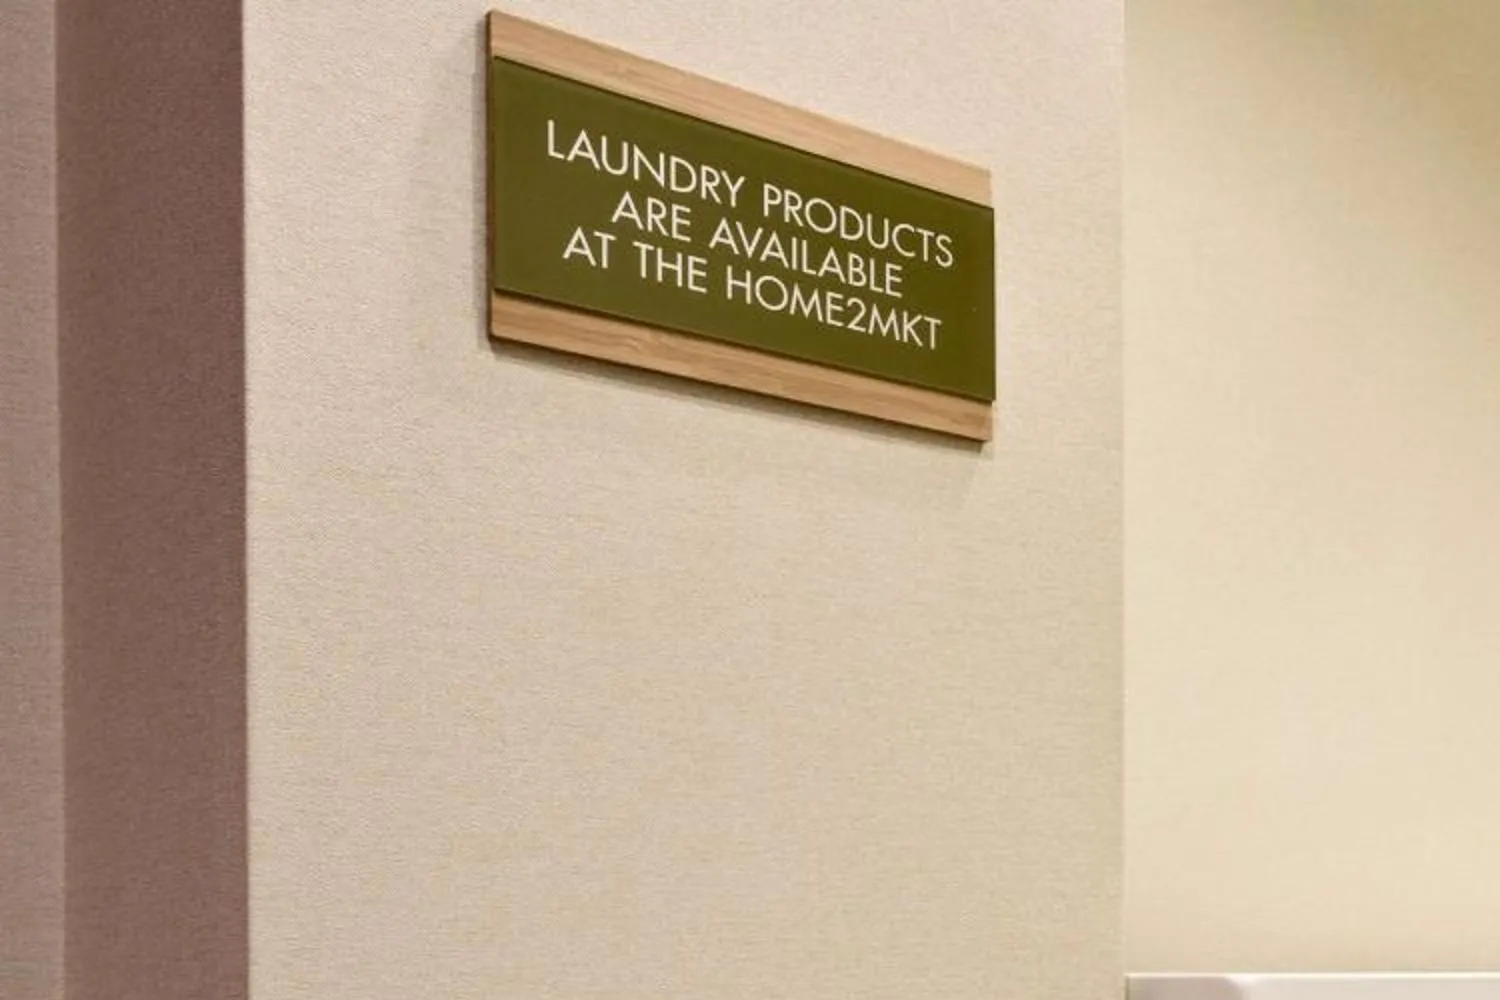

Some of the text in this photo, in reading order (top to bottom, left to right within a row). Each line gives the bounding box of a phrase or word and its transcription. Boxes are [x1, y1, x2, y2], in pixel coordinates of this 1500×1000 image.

[546, 119, 954, 268] LAUNDRY PRODUCTS
[611, 191, 903, 298] ARE AVAILABLE
[562, 226, 942, 350] AT THE HOME2MKT
